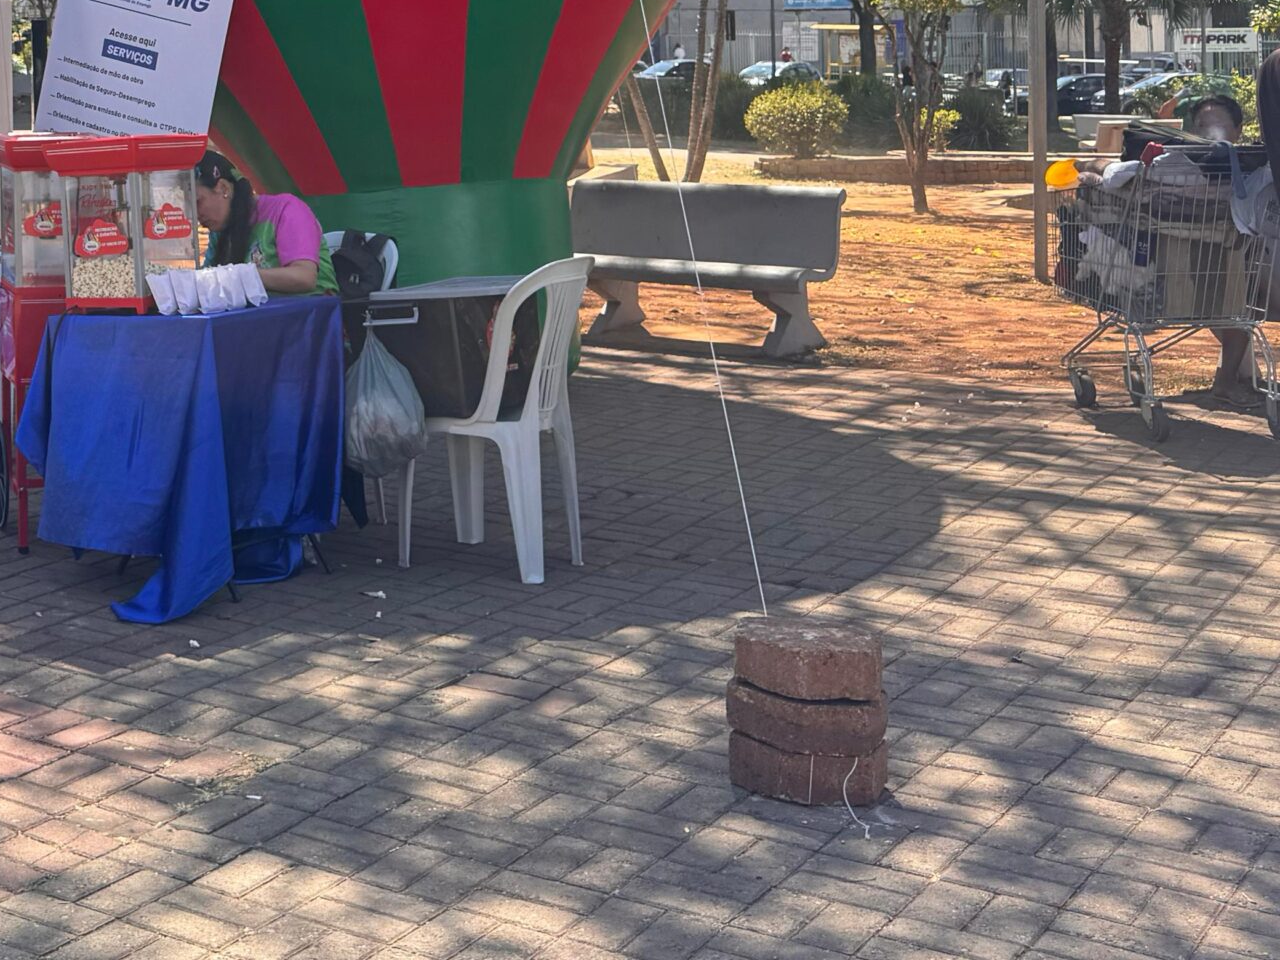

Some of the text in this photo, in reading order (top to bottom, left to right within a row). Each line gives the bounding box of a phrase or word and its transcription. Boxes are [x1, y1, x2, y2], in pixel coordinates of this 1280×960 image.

[109, 27, 157, 48] Acesse aqui
[106, 44, 153, 65] SERVIÇOS
[96, 85, 156, 108] Seguro-Desemprego
[159, 123, 177, 133] CTPS
